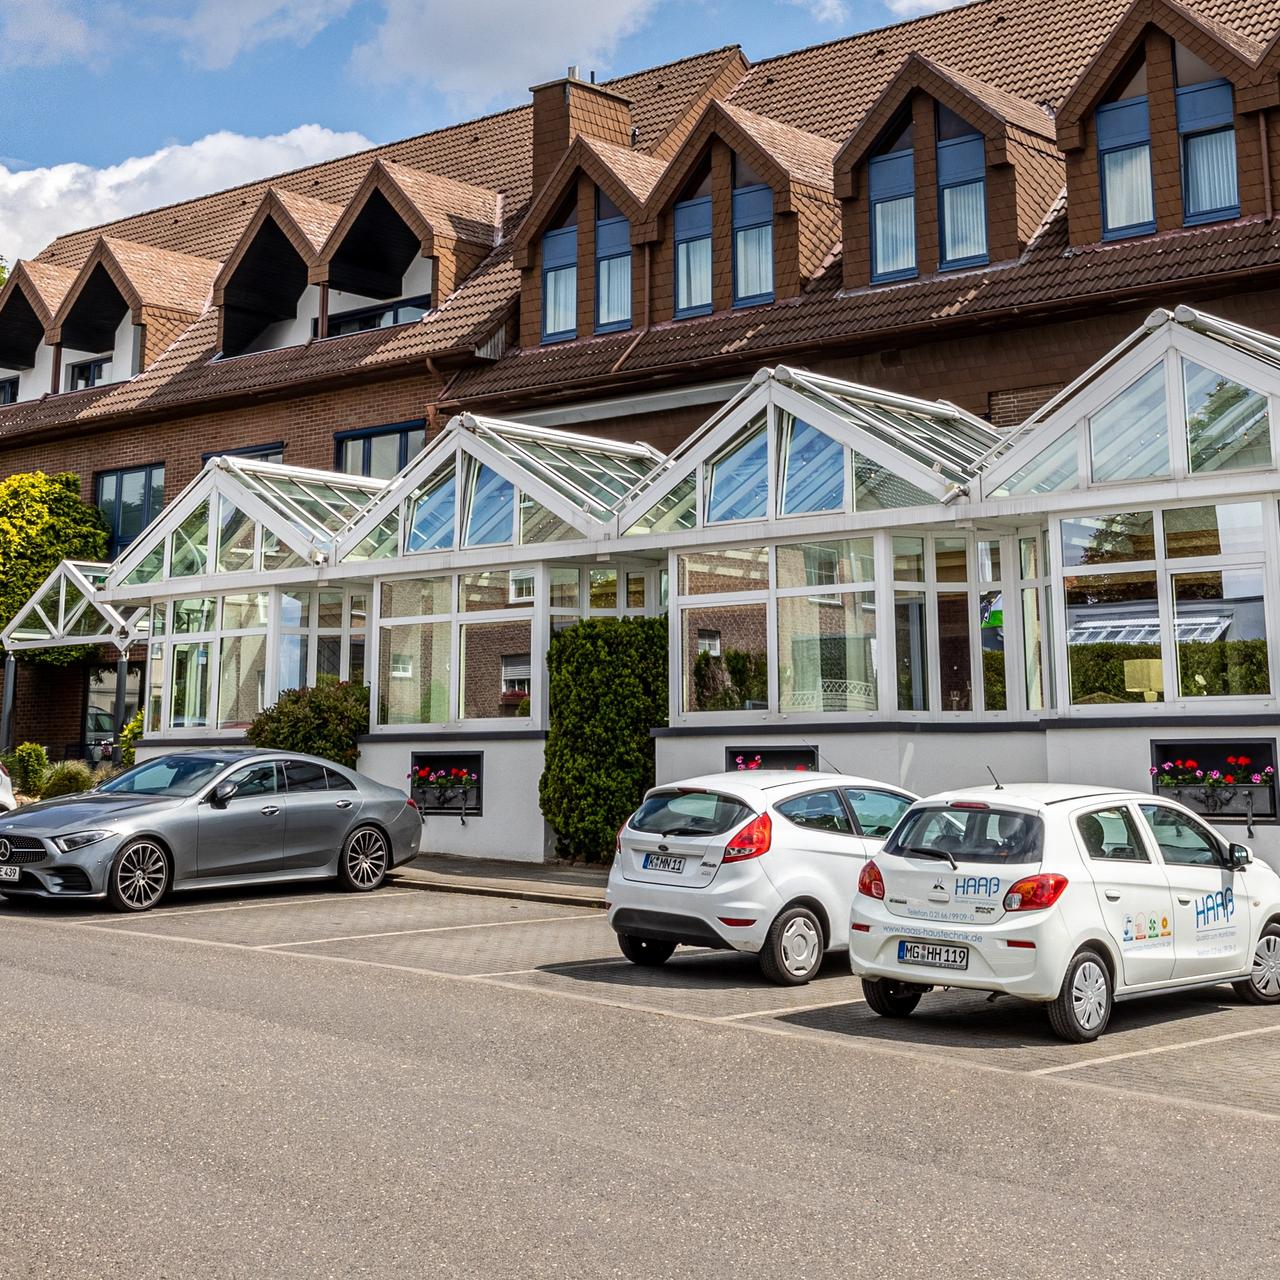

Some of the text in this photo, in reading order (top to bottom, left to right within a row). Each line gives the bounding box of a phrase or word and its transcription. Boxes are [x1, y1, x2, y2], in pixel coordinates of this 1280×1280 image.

[649, 855, 656, 867] K
[659, 858, 671, 869] MN
[5, 868, 17, 877] 439
[882, 925, 983, 943] www.haass-haustechnik.de
[906, 945, 966, 963] MG HH 119
